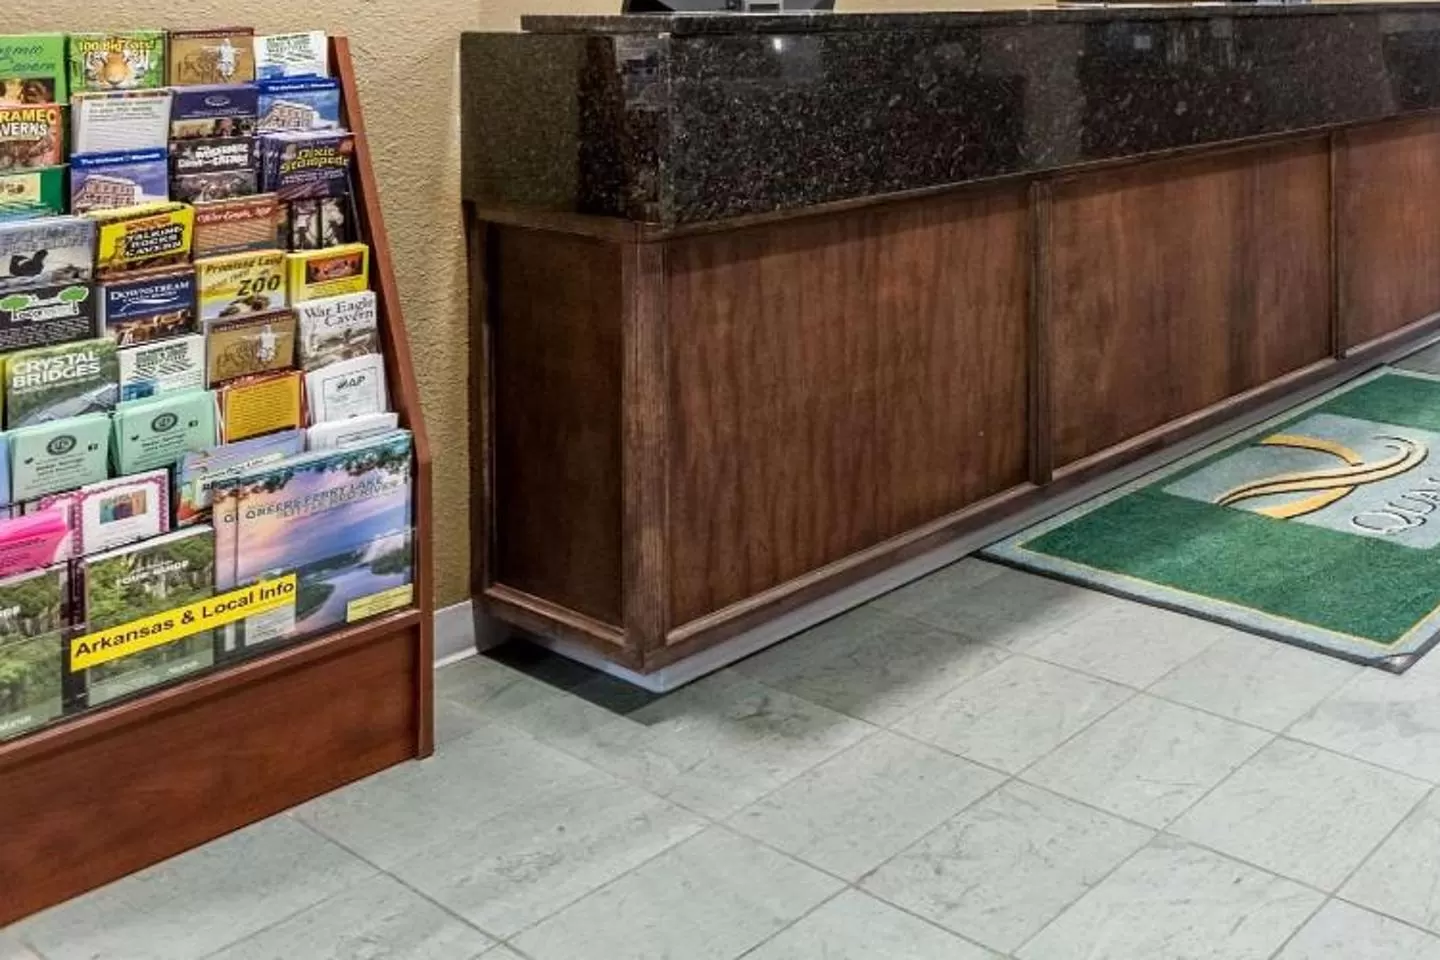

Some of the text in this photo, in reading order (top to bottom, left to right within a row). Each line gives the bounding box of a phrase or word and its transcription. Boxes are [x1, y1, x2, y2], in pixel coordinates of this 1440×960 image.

[110, 281, 190, 301] DOWNSTREAM
[237, 273, 282, 297] ZOO
[305, 297, 374, 319] War Eagle
[325, 309, 374, 327] Cavern
[12, 350, 101, 376] CRYSTAL
[12, 363, 101, 389] BRIDGES
[75, 580, 295, 659] Arkansas & Local Info
